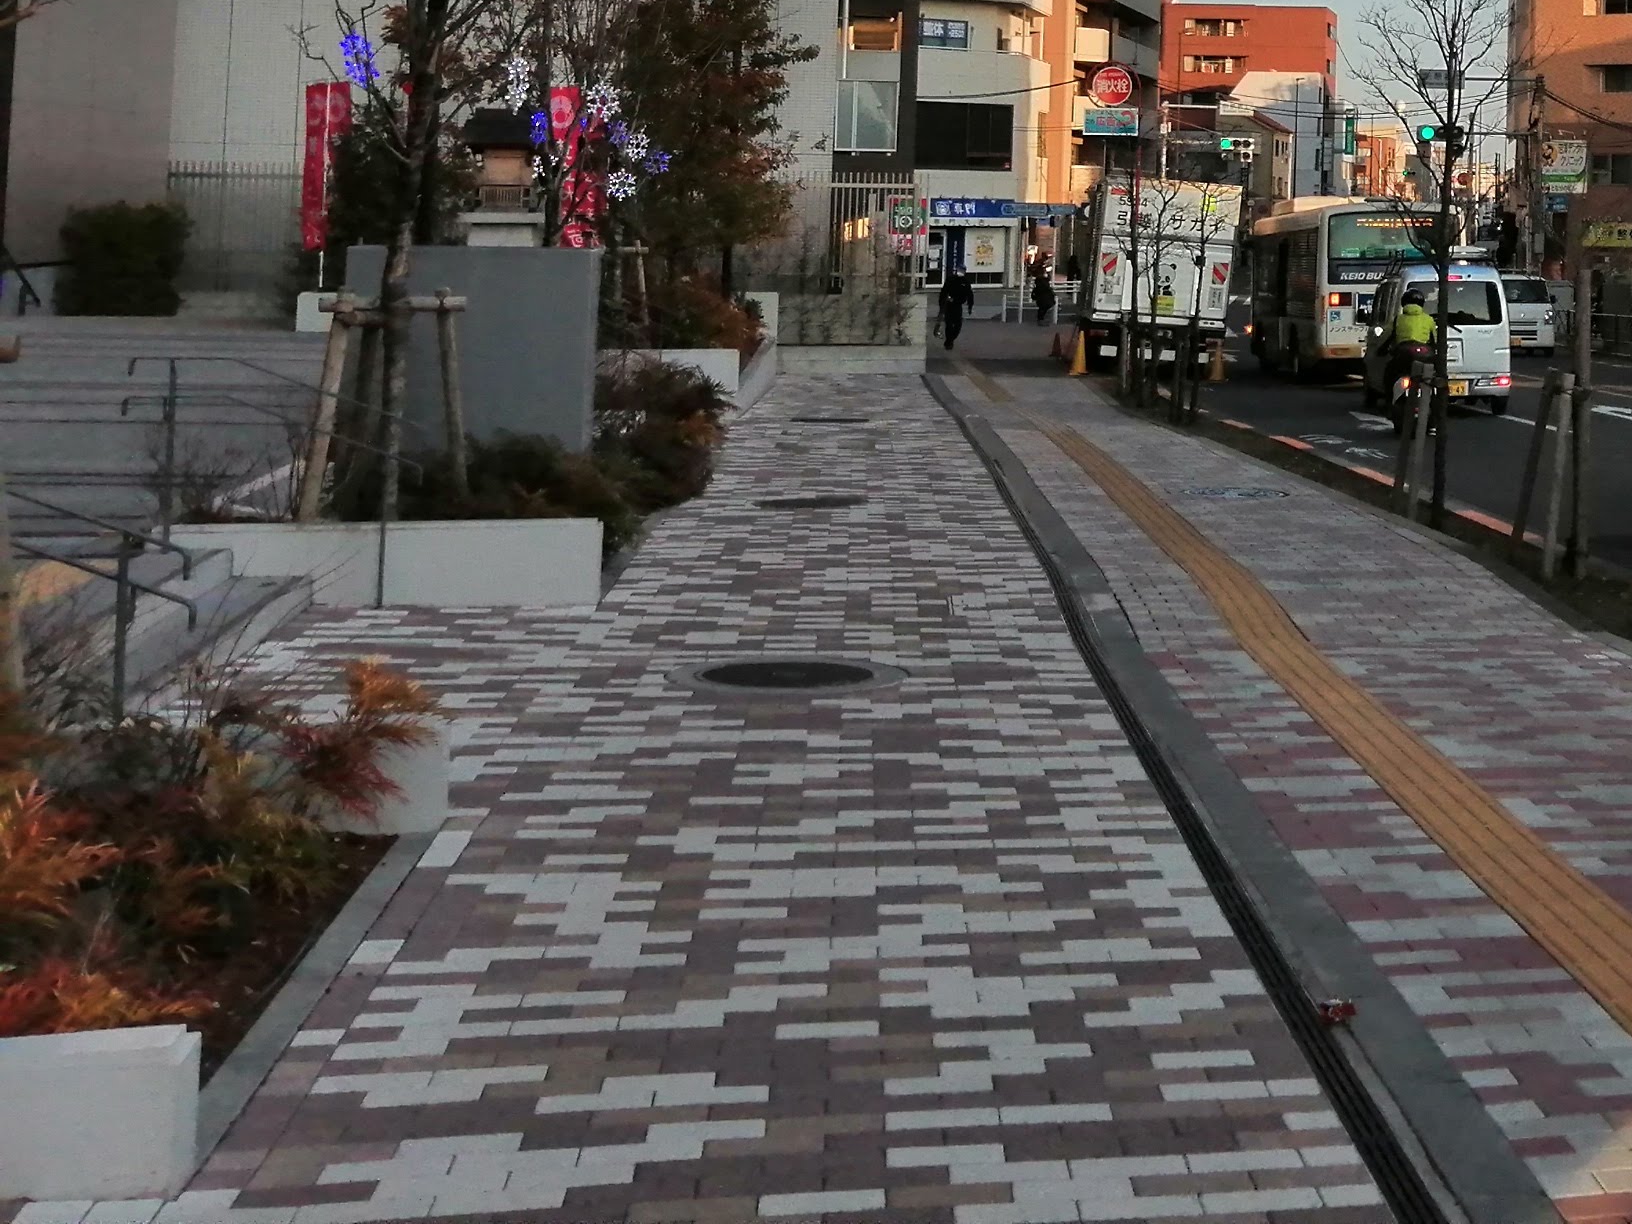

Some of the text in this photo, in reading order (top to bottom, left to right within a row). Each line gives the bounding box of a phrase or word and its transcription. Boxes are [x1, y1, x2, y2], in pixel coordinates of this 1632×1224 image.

[1097, 79, 1129, 93] 消火栓
[1340, 272, 1365, 280] KEIO
